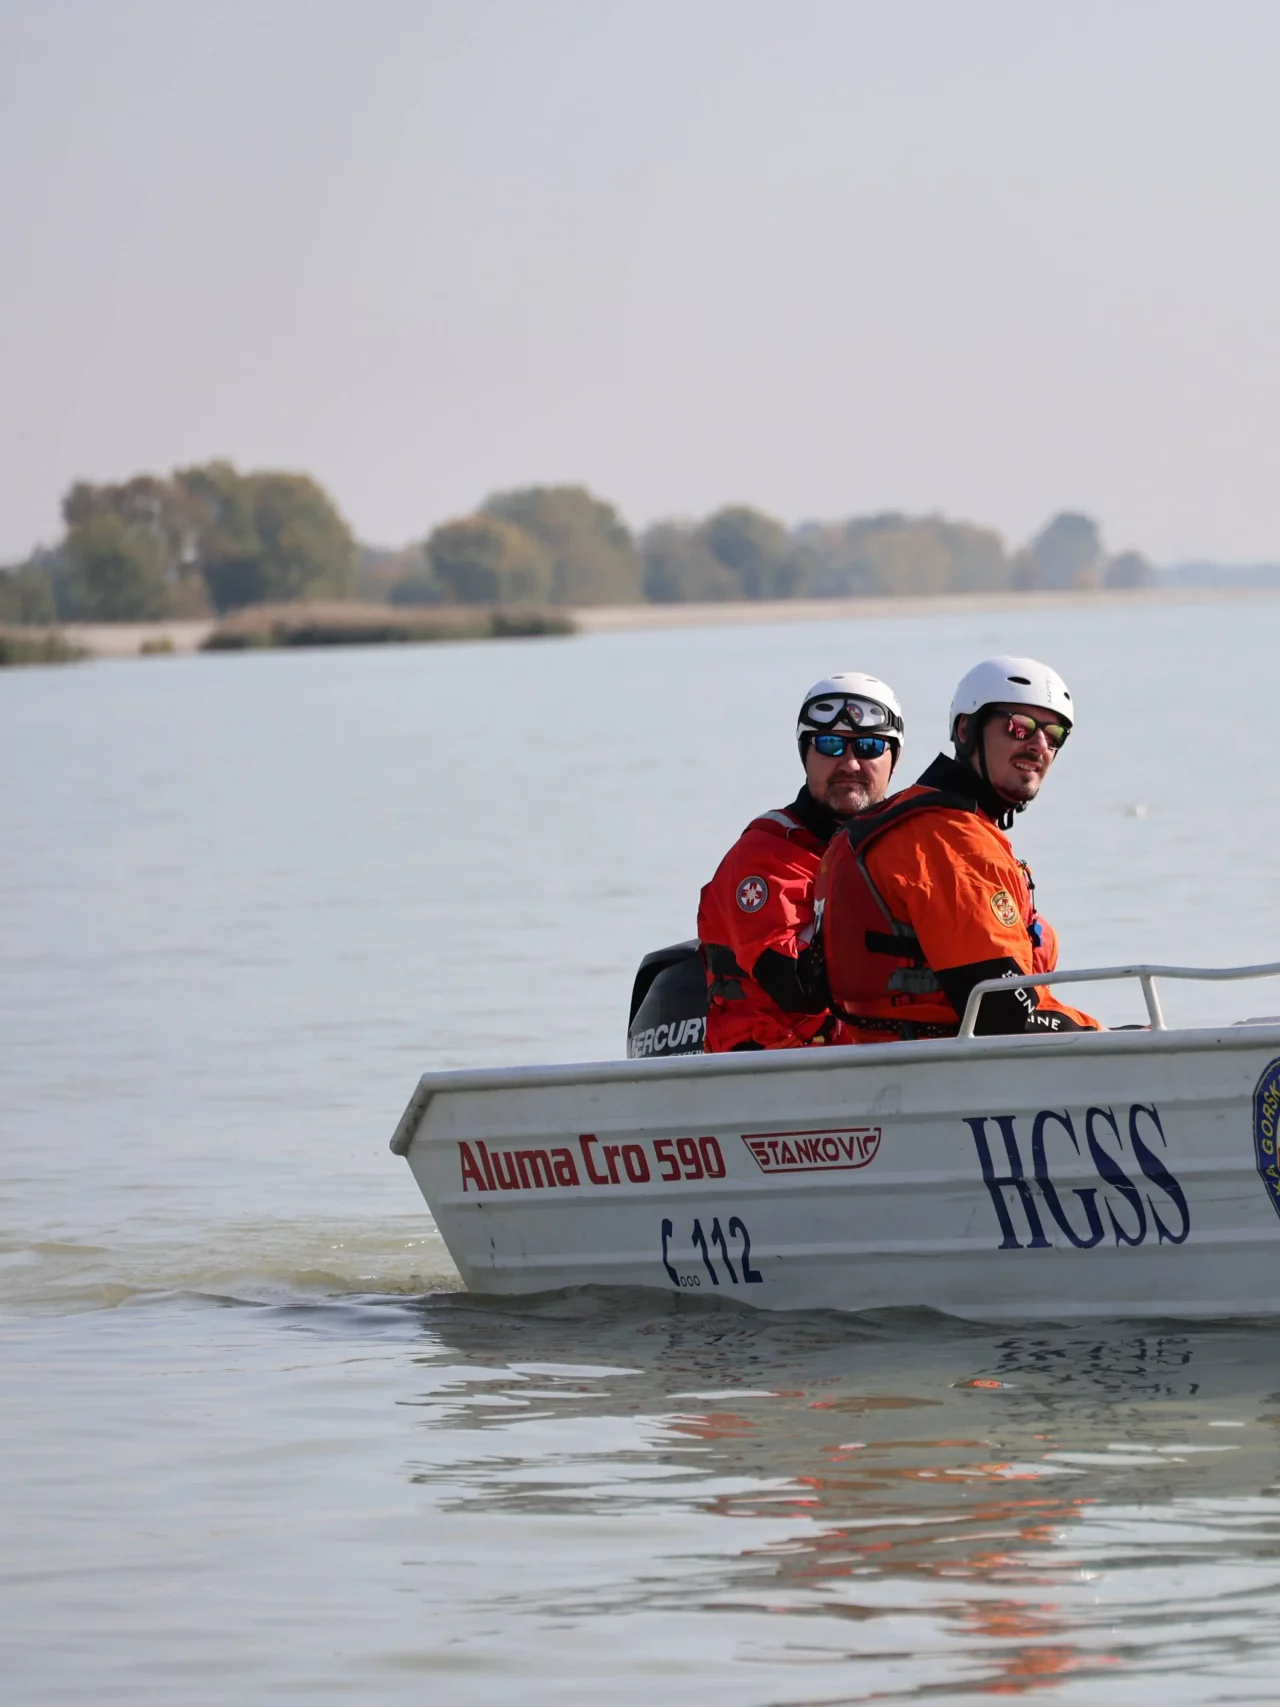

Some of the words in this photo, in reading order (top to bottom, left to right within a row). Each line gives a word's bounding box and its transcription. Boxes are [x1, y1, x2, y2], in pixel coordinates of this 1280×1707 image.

[458, 1140, 580, 1192] Aluma
[579, 1134, 650, 1185] Cro
[655, 1136, 727, 1182] 590
[962, 1103, 1190, 1249] HGSS
[691, 1216, 763, 1286] 112
